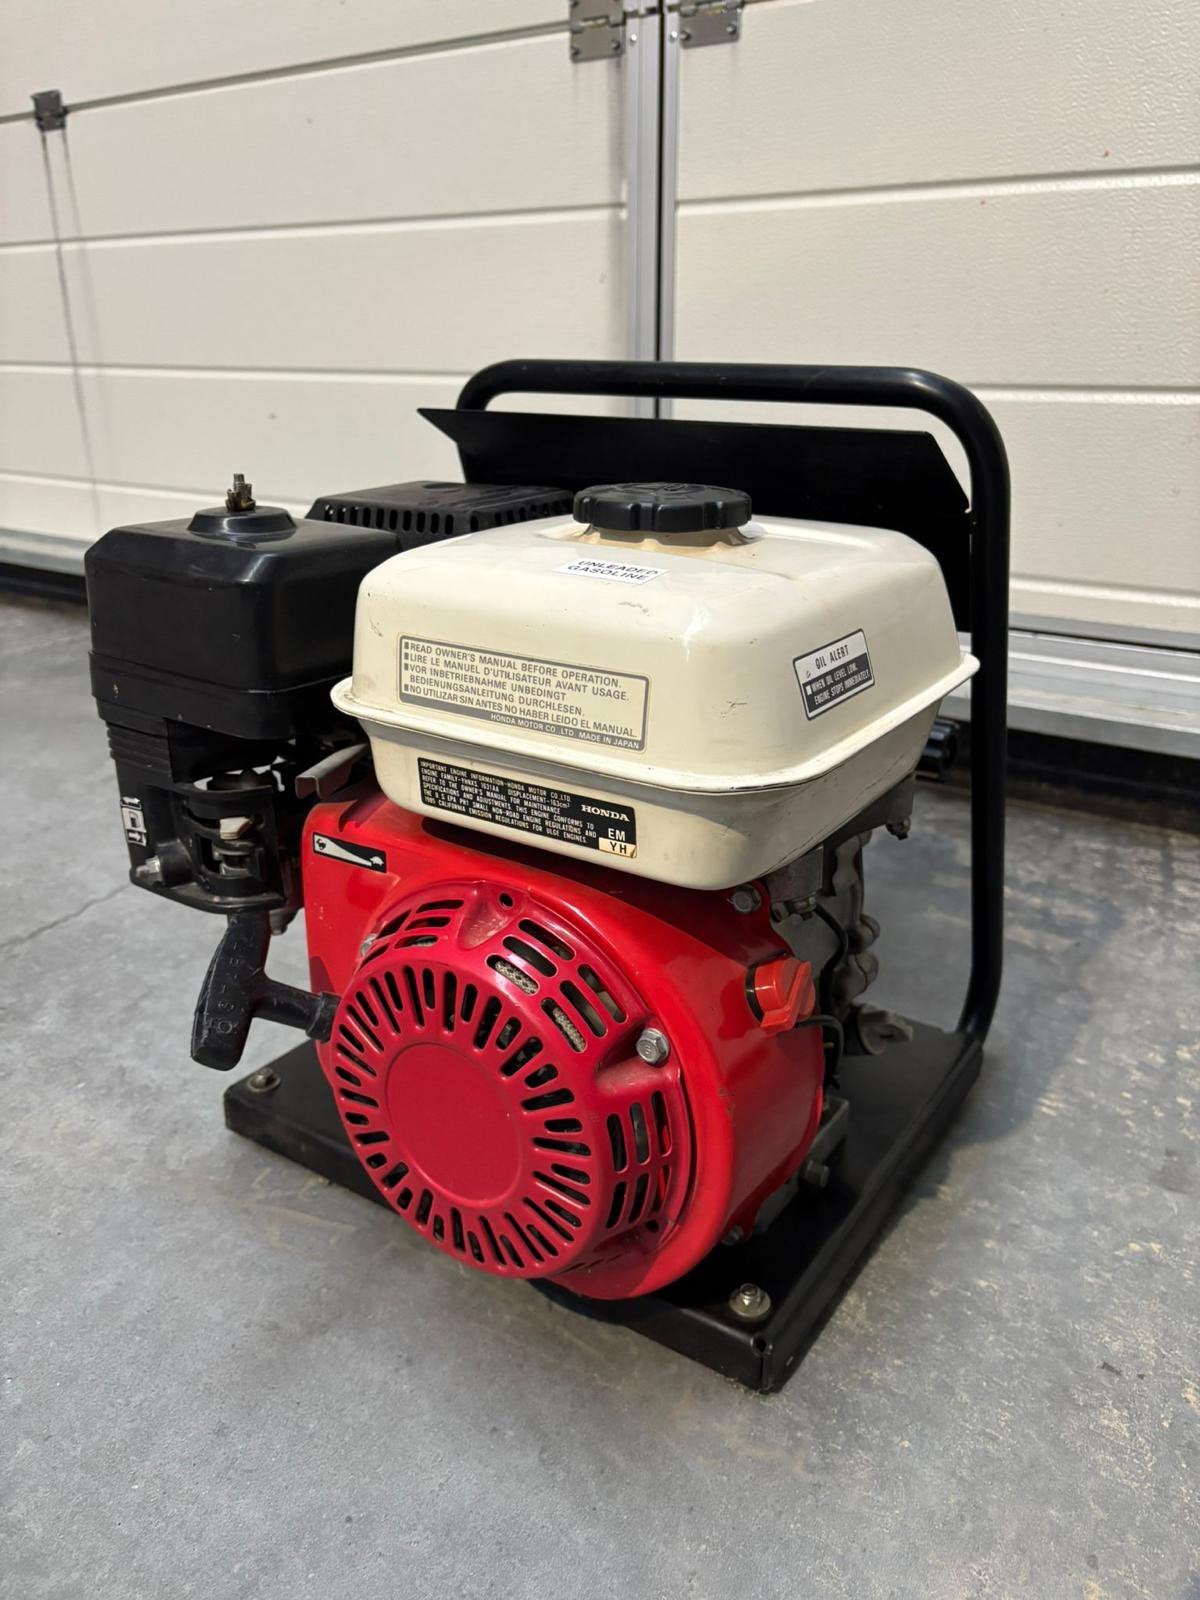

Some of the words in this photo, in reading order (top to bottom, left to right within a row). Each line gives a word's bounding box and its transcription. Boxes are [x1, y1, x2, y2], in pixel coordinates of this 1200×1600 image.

[568, 566, 649, 581] GASOLINE
[579, 561, 658, 575] UNLEADED
[410, 643, 432, 654] READ
[435, 647, 476, 662] OWNER'S
[479, 655, 517, 670] MANUAL
[521, 663, 558, 677] BEFORE
[561, 670, 622, 689] OPERATION.
[815, 656, 827, 670] OIL
[829, 644, 849, 664] ALERT
[410, 653, 427, 664] LIRE
[431, 657, 440, 666] LE
[444, 659, 480, 674] MANUEL
[484, 667, 551, 687] D'UTILISATEUR
[555, 680, 588, 694] AVANT
[592, 686, 630, 701] USAGE.
[410, 664, 427, 675] VOR
[430, 668, 506, 690] INBETRIEBNAHME
[511, 683, 566, 702] UNBEDINGT
[814, 689, 830, 705] ENGINE
[830, 682, 845, 697] STOPS
[410, 674, 514, 702] BEDIENUNGSANLEITUNG
[518, 695, 585, 716] DURCHLESEN.
[410, 685, 421, 695] NO
[423, 687, 458, 702] UTILIZAR
[460, 695, 474, 705] SIN
[475, 698, 502, 711] ANTES
[504, 704, 517, 714] NO
[519, 707, 549, 720] HABER
[551, 713, 578, 726] LEIDO
[580, 719, 590, 729] EL
[593, 721, 637, 738] MANUAL.
[491, 713, 516, 725] HONDA
[518, 719, 544, 730] MOTOR
[579, 731, 600, 742] MADE
[603, 736, 611, 744] IN
[613, 738, 639, 750] JAPAN
[420, 761, 447, 773] IMPORTANT
[450, 768, 468, 778] ENGINE
[528, 786, 547, 796] MOTOR
[421, 767, 438, 777] ENGINE
[422, 774, 436, 784] REFER
[449, 781, 458, 789] THE
[460, 784, 483, 795] OWNER'S
[486, 790, 507, 801] MANUAL
[510, 796, 521, 805] FOR
[523, 799, 561, 815] MAINTENANCE
[423, 782, 460, 797] SPECIFICATIONS
[463, 792, 473, 800] AND
[516, 805, 528, 814] THIS
[531, 809, 550, 819] ENGINE
[553, 814, 583, 828] CONFORMS
[424, 789, 432, 797] THE
[472, 801, 488, 811] SMALL
[492, 806, 520, 819] NON-ROAD
[522, 814, 542, 825] ENGINE
[544, 819, 582, 835] REGULATIONS
[585, 829, 597, 839] AND
[438, 800, 466, 813] CALIFORNIA
[468, 807, 492, 819] EMISSION
[495, 814, 529, 829] REGULATIONS
[532, 824, 543, 833] FOR
[581, 804, 630, 822] HONDA
[608, 827, 626, 842] EM
[609, 841, 627, 854] YH
